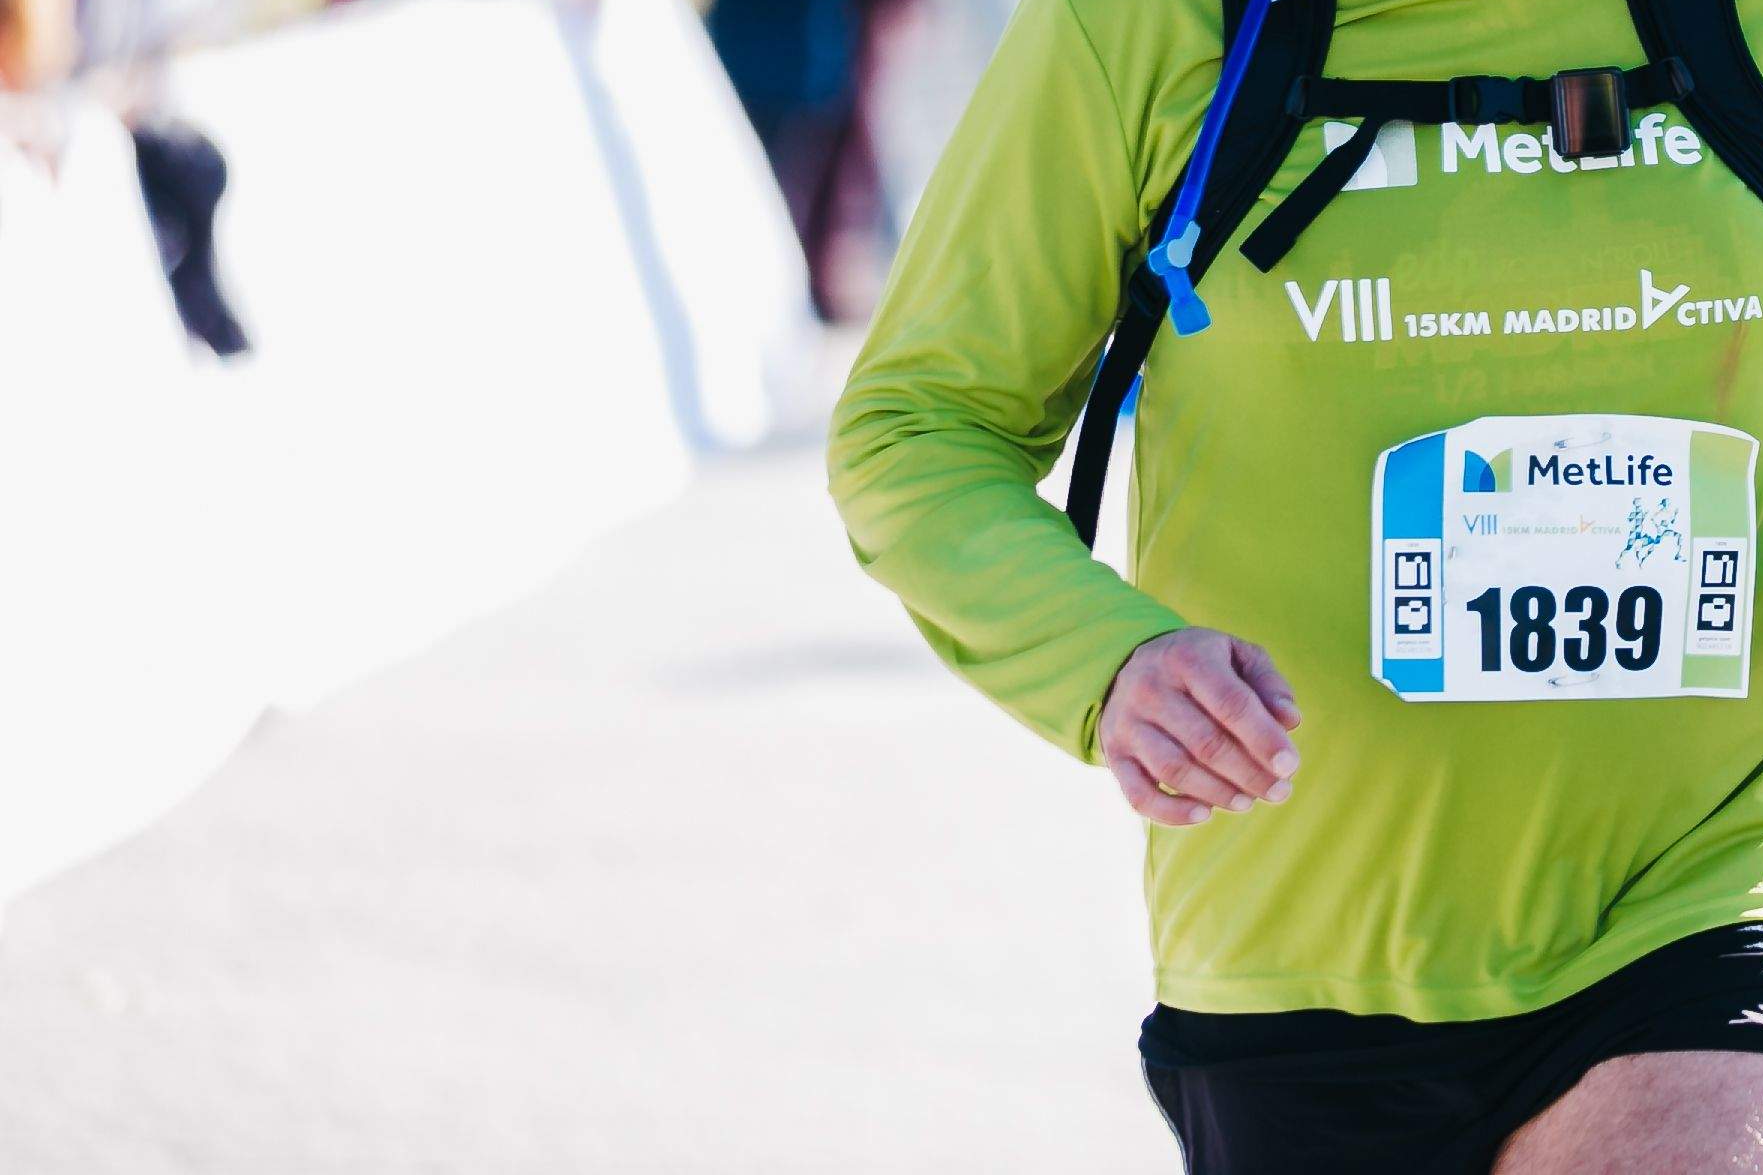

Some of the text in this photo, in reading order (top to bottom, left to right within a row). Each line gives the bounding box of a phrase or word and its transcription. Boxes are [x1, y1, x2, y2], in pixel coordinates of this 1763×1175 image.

[1441, 112, 1703, 174] Metfe
[1284, 277, 1394, 343] VIII
[1403, 310, 1492, 339] 15KM
[1502, 306, 1637, 336] MADRID
[1527, 454, 1673, 486] MetLife
[1462, 514, 1498, 536] VIII
[1466, 585, 1663, 673] 1839
